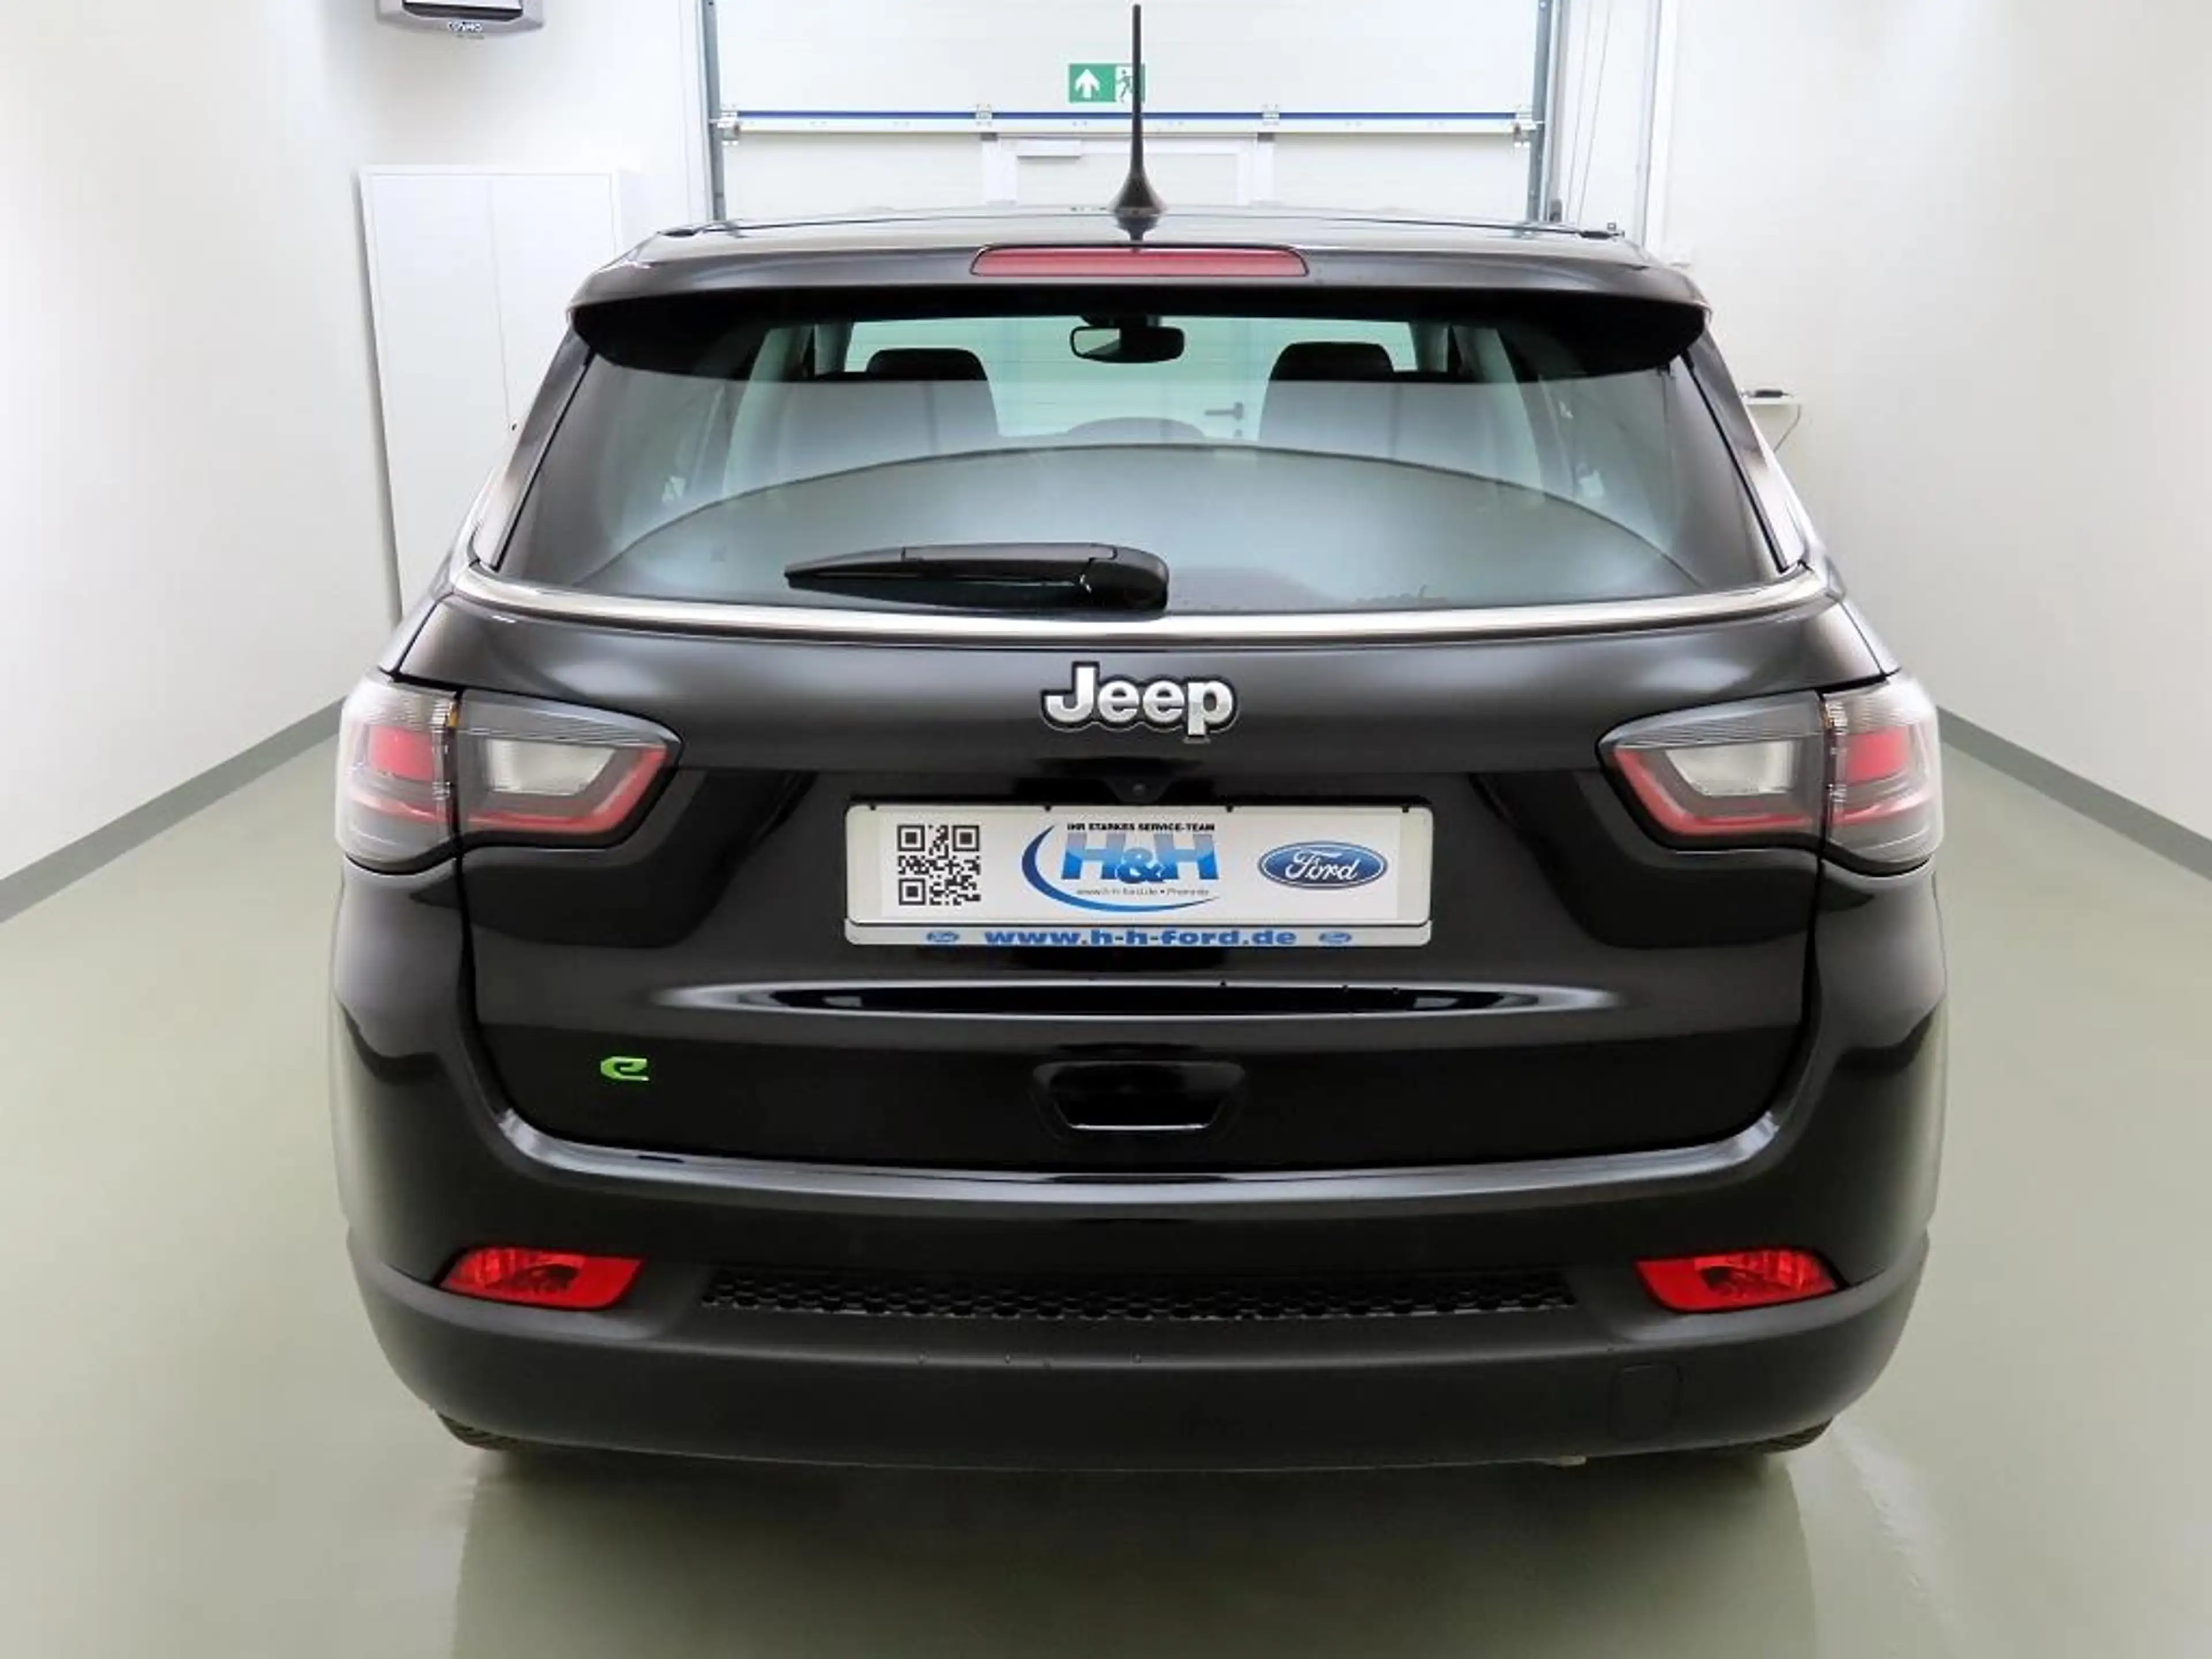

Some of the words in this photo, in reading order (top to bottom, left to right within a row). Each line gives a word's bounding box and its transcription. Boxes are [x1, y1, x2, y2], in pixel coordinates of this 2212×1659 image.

[1043, 664, 1235, 737] Jeep
[1067, 823, 1086, 831] IHR
[1088, 823, 1135, 831] STARKES
[1138, 823, 1215, 831] SERVICE-TEAM
[1061, 833, 1218, 884] H&H
[1285, 846, 1361, 881] Ford
[984, 929, 1297, 945] www.h-h-ford.de
